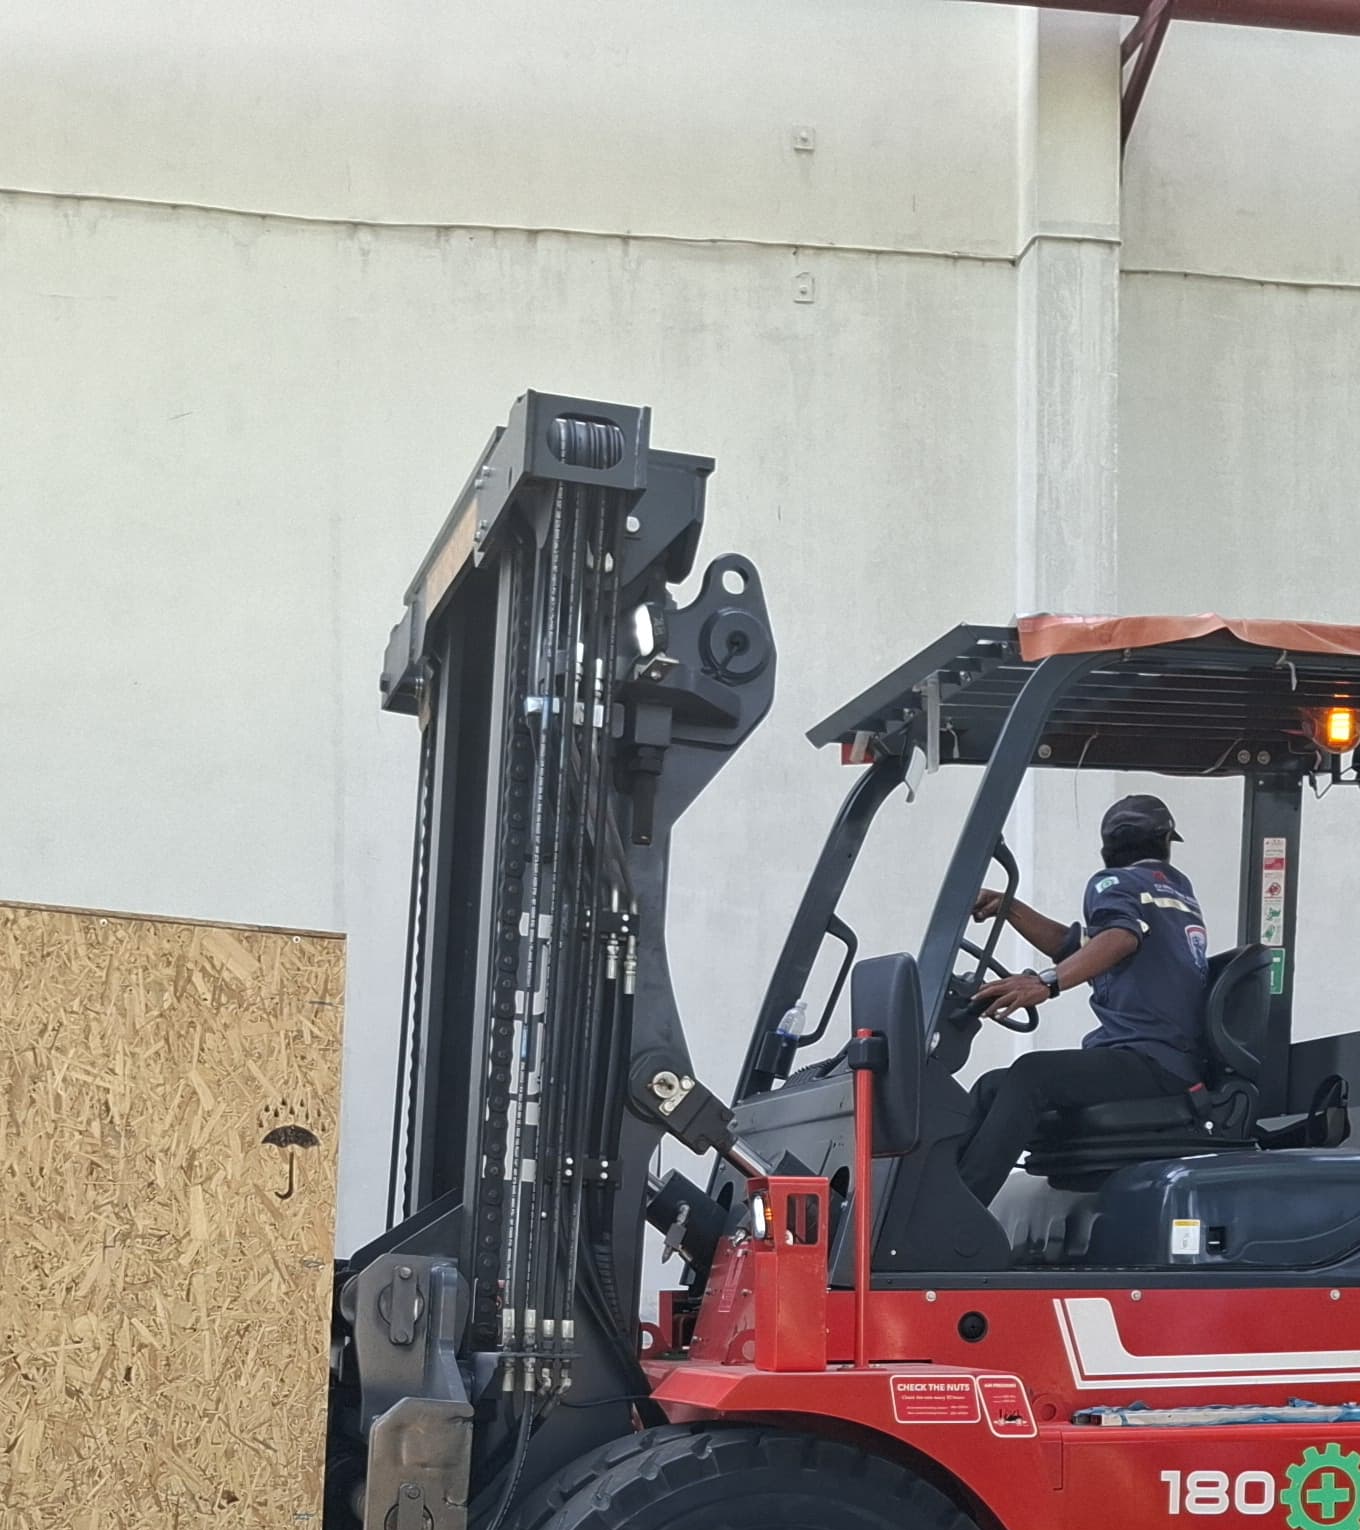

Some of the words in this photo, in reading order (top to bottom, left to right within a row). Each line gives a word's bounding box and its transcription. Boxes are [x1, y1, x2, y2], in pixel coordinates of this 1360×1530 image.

[897, 1383, 927, 1392] CHECK
[928, 1383, 945, 1392] THE
[946, 1383, 970, 1392] NUTS
[1160, 1470, 1276, 1515] 180
